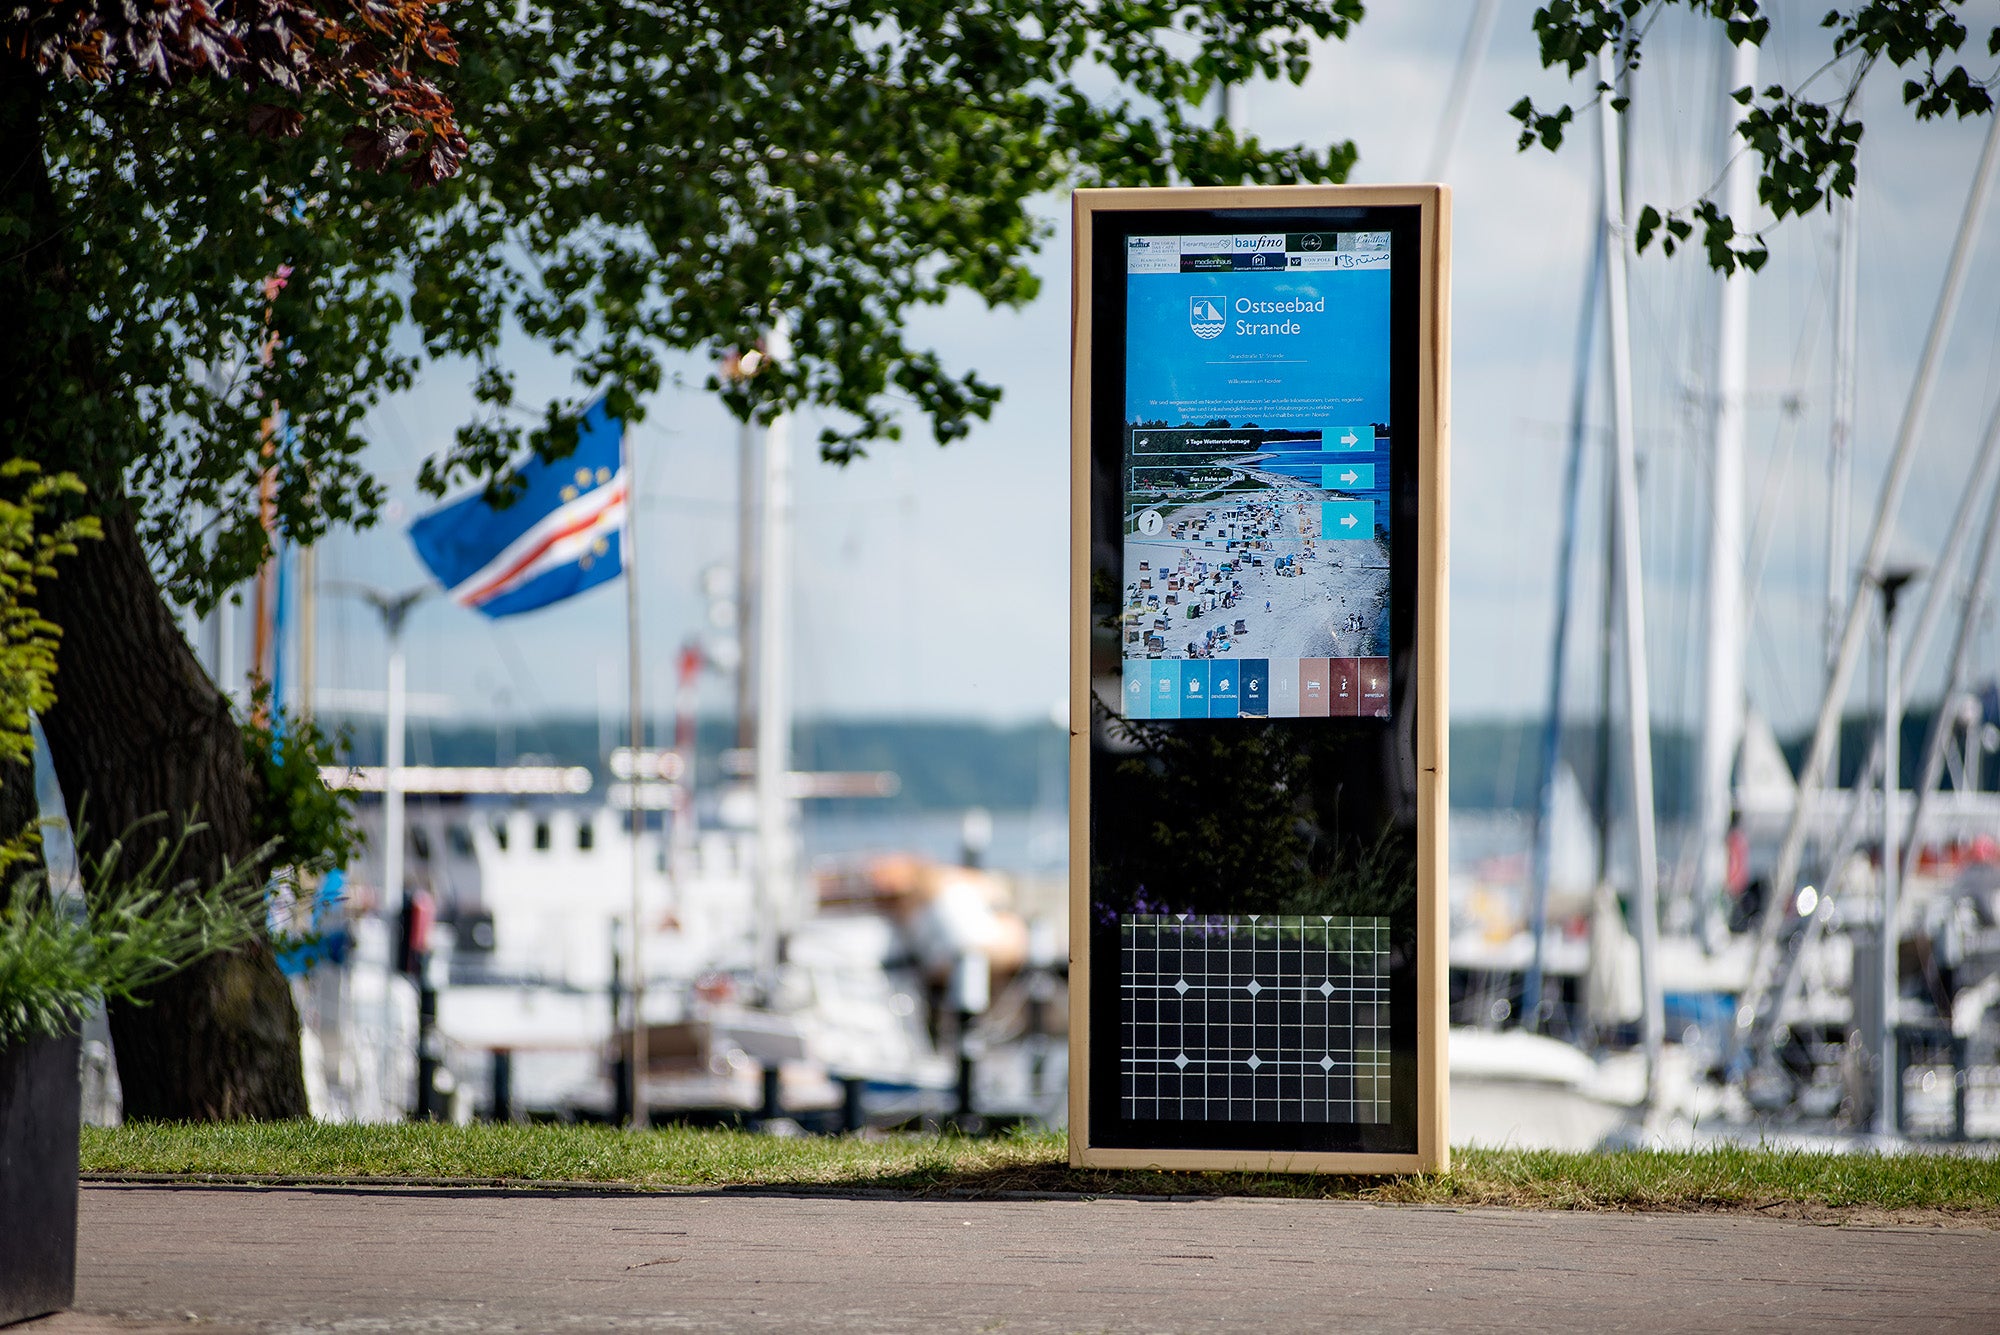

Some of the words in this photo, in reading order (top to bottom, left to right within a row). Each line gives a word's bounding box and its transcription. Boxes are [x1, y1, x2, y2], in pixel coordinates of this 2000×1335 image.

[1235, 235, 1282, 252] baufino
[1235, 296, 1325, 314] Ostseebad
[1236, 318, 1301, 336] Strande
